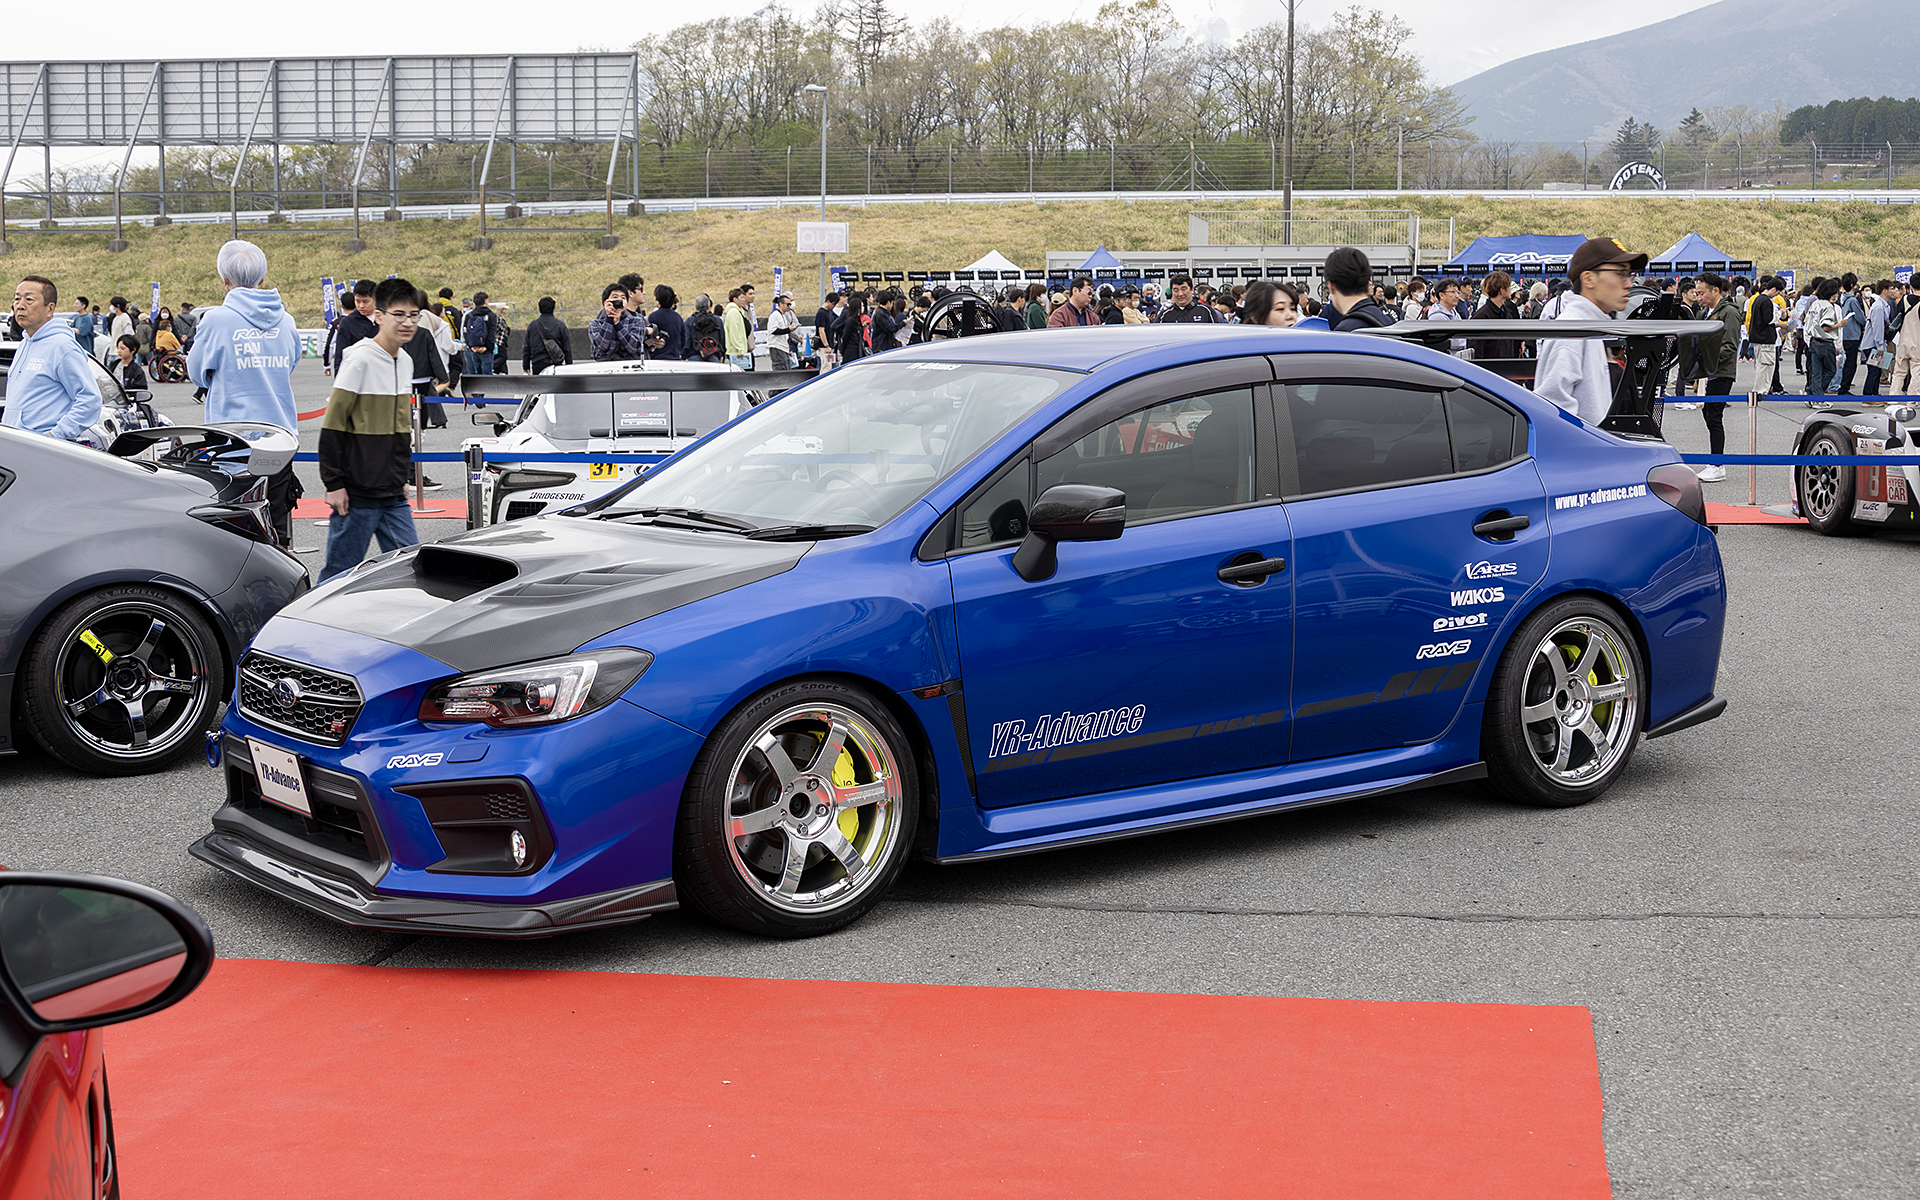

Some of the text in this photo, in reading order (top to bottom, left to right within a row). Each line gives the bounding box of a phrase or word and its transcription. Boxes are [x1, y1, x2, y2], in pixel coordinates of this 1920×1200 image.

[1488, 252, 1574, 264] RAYS
[232, 328, 280, 341] RAYS
[234, 342, 260, 356] FAN
[253, 459, 282, 467] XENO
[592, 463, 614, 476] 31
[1887, 477, 1905, 487] HYPER
[529, 491, 586, 501] BRIDGESTONE
[1555, 484, 1647, 510] www.yr-advance.com
[1888, 486, 1906, 501] CAR
[1862, 502, 1880, 511] WEC
[112, 588, 165, 599] MICHELIN
[1416, 639, 1472, 660] RAYS
[745, 685, 797, 719] PROXES
[989, 703, 1147, 759] YR-Advance
[386, 752, 444, 769] RAYS
[259, 761, 301, 793] YR-Advance
